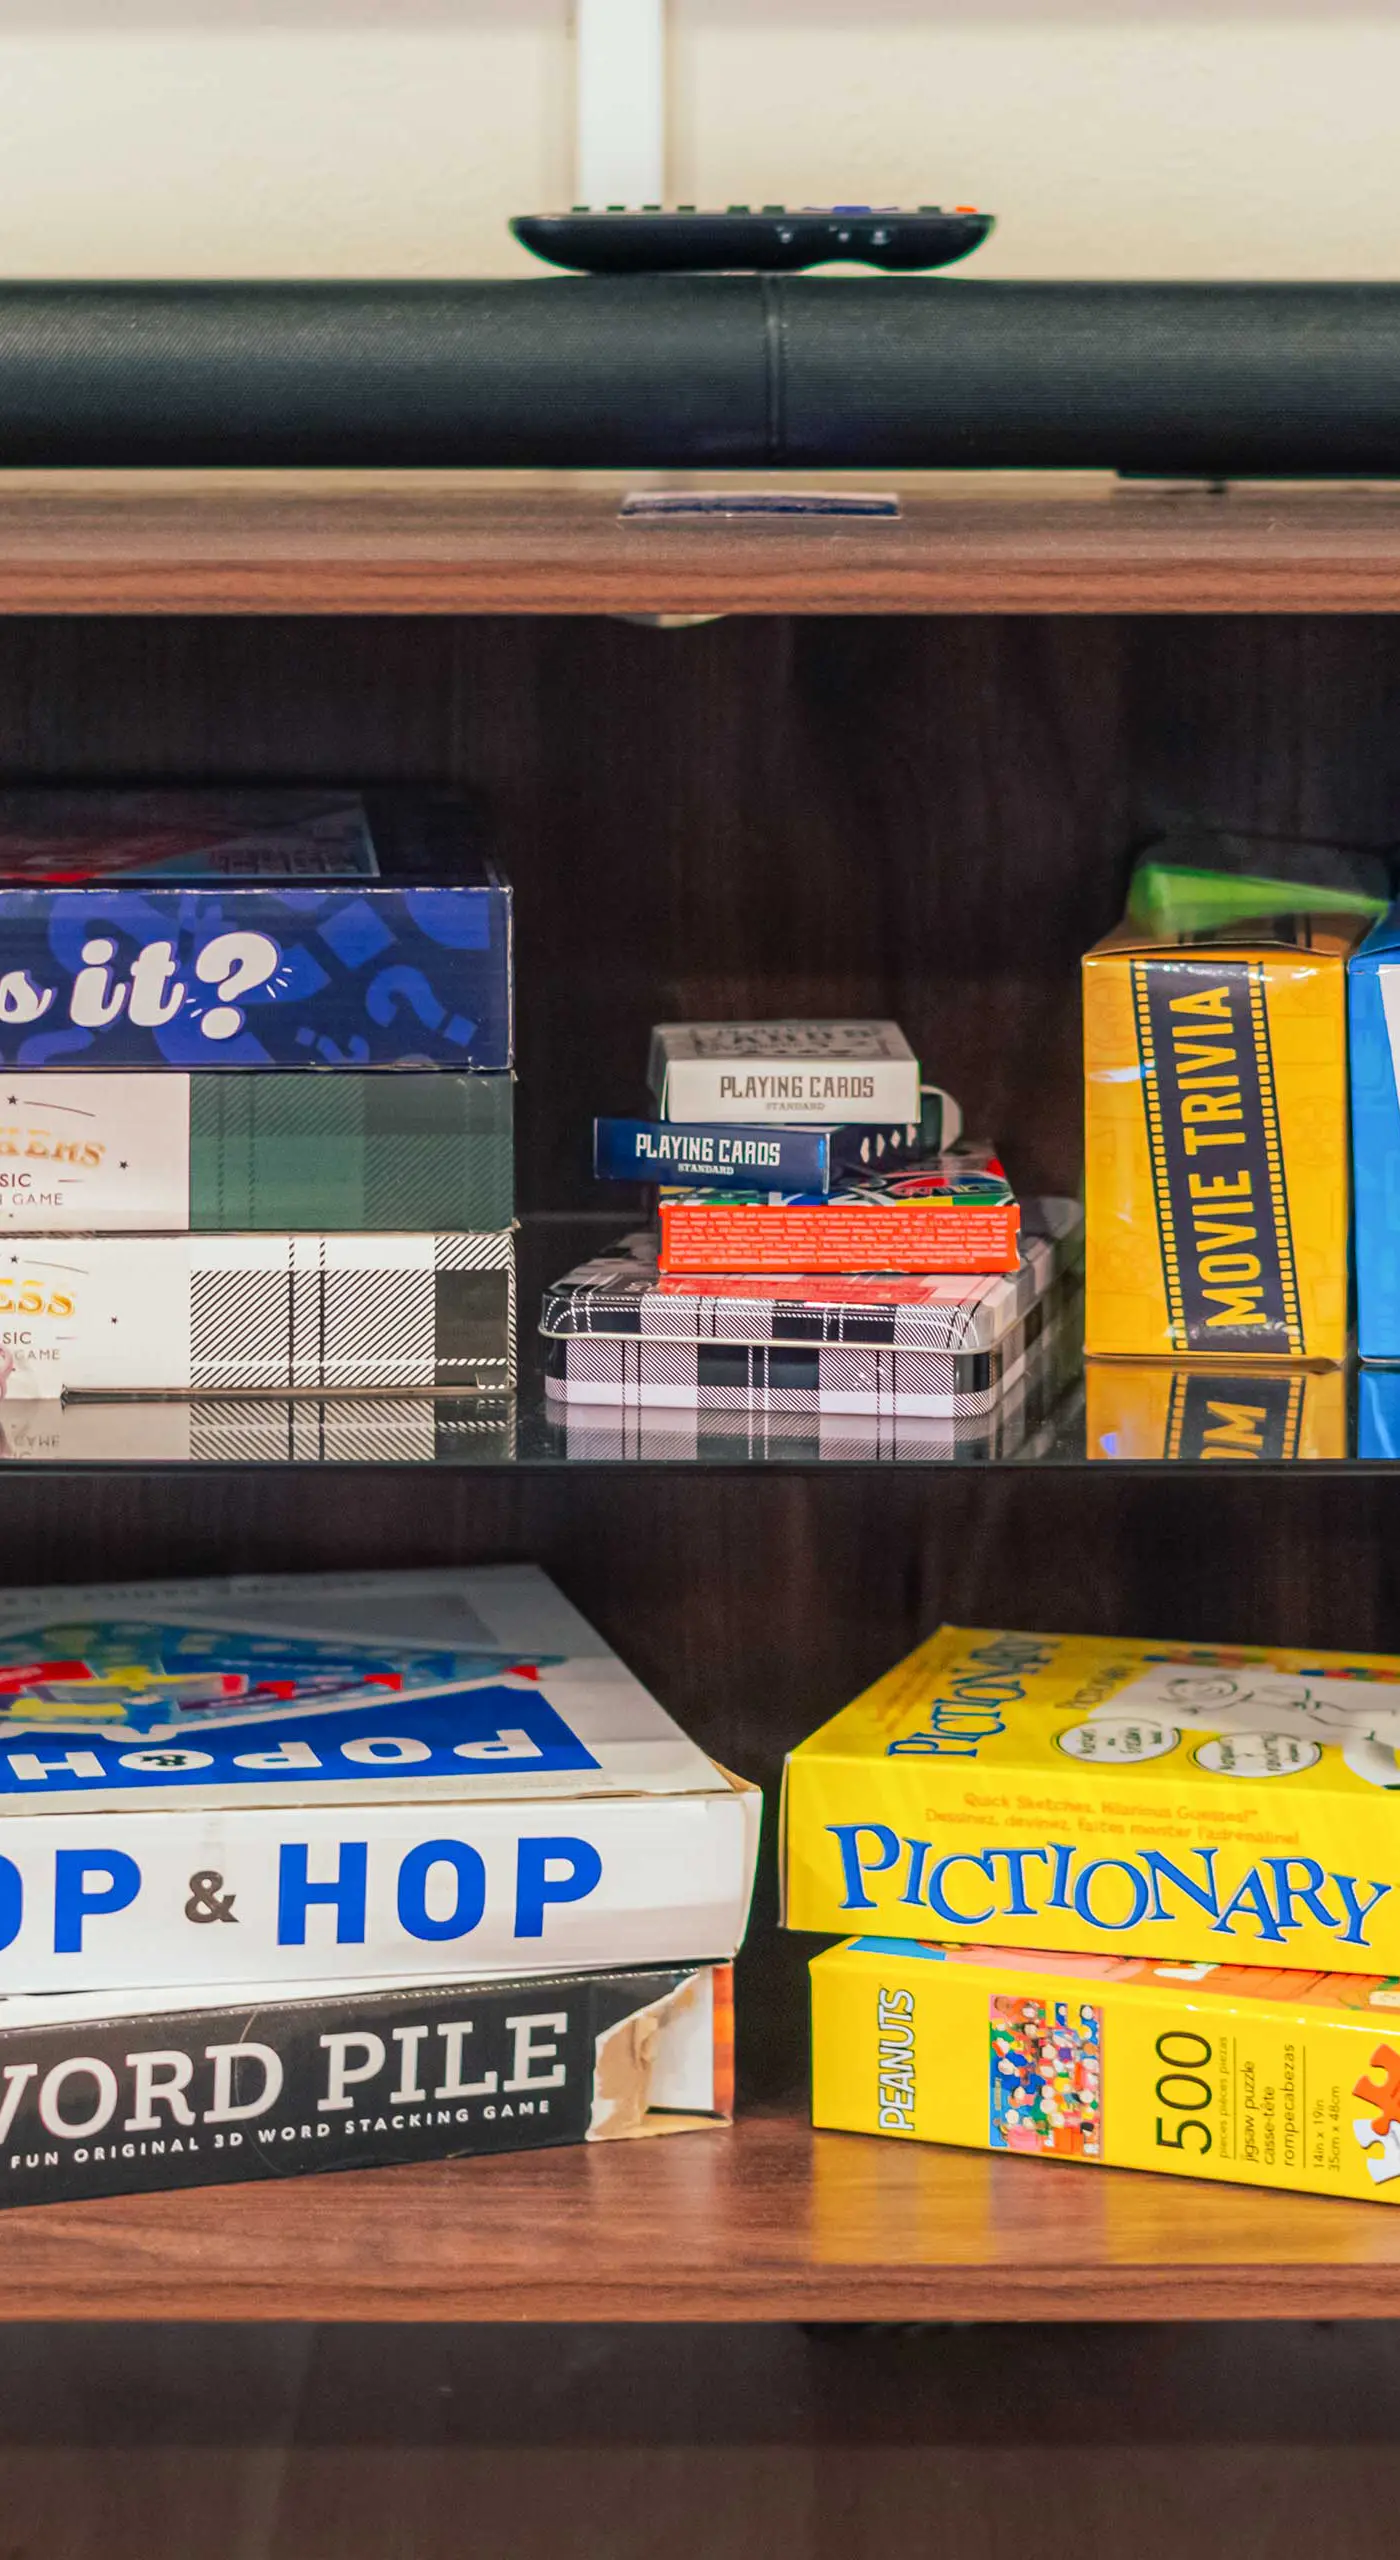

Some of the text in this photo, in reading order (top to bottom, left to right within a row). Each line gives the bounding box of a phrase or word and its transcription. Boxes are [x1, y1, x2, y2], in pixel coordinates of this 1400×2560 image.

[70, 931, 279, 1040] it?
[720, 1076, 875, 1099] PLAYING CARDS
[1169, 986, 1246, 1156] TRIVIA
[765, 1102, 826, 1112] STANDARD
[635, 1133, 781, 1167] PLAYING CARDS
[677, 1163, 735, 1175] STANDARD
[12, 1192, 64, 1206] GAME
[1188, 1170, 1267, 1327] MOVIE
[2, 1331, 33, 1345] SIC
[232, 1727, 543, 1770] POP
[963, 1792, 1010, 1809] Quick
[0, 1836, 603, 1956] P & HOP
[824, 1822, 1392, 1947] PICTIONARY
[317, 2011, 568, 2113] PILE
[878, 1987, 916, 2132] PEANUTS
[1218, 2036, 1231, 2075] piezas
[1155, 2030, 1213, 2156] 500
[1239, 2060, 1260, 2163] jigsaw puzzle
[1259, 2086, 1276, 2166] casse-tête
[1278, 2043, 1300, 2167] rompecabezas
[11, 2099, 550, 2170] FUN ORIGINAL 3D WORD STACKING GAME
[1218, 2120, 1231, 2160] pieces
[1312, 2098, 1325, 2169] 14in x 19in
[1331, 2125, 1340, 2133] x
